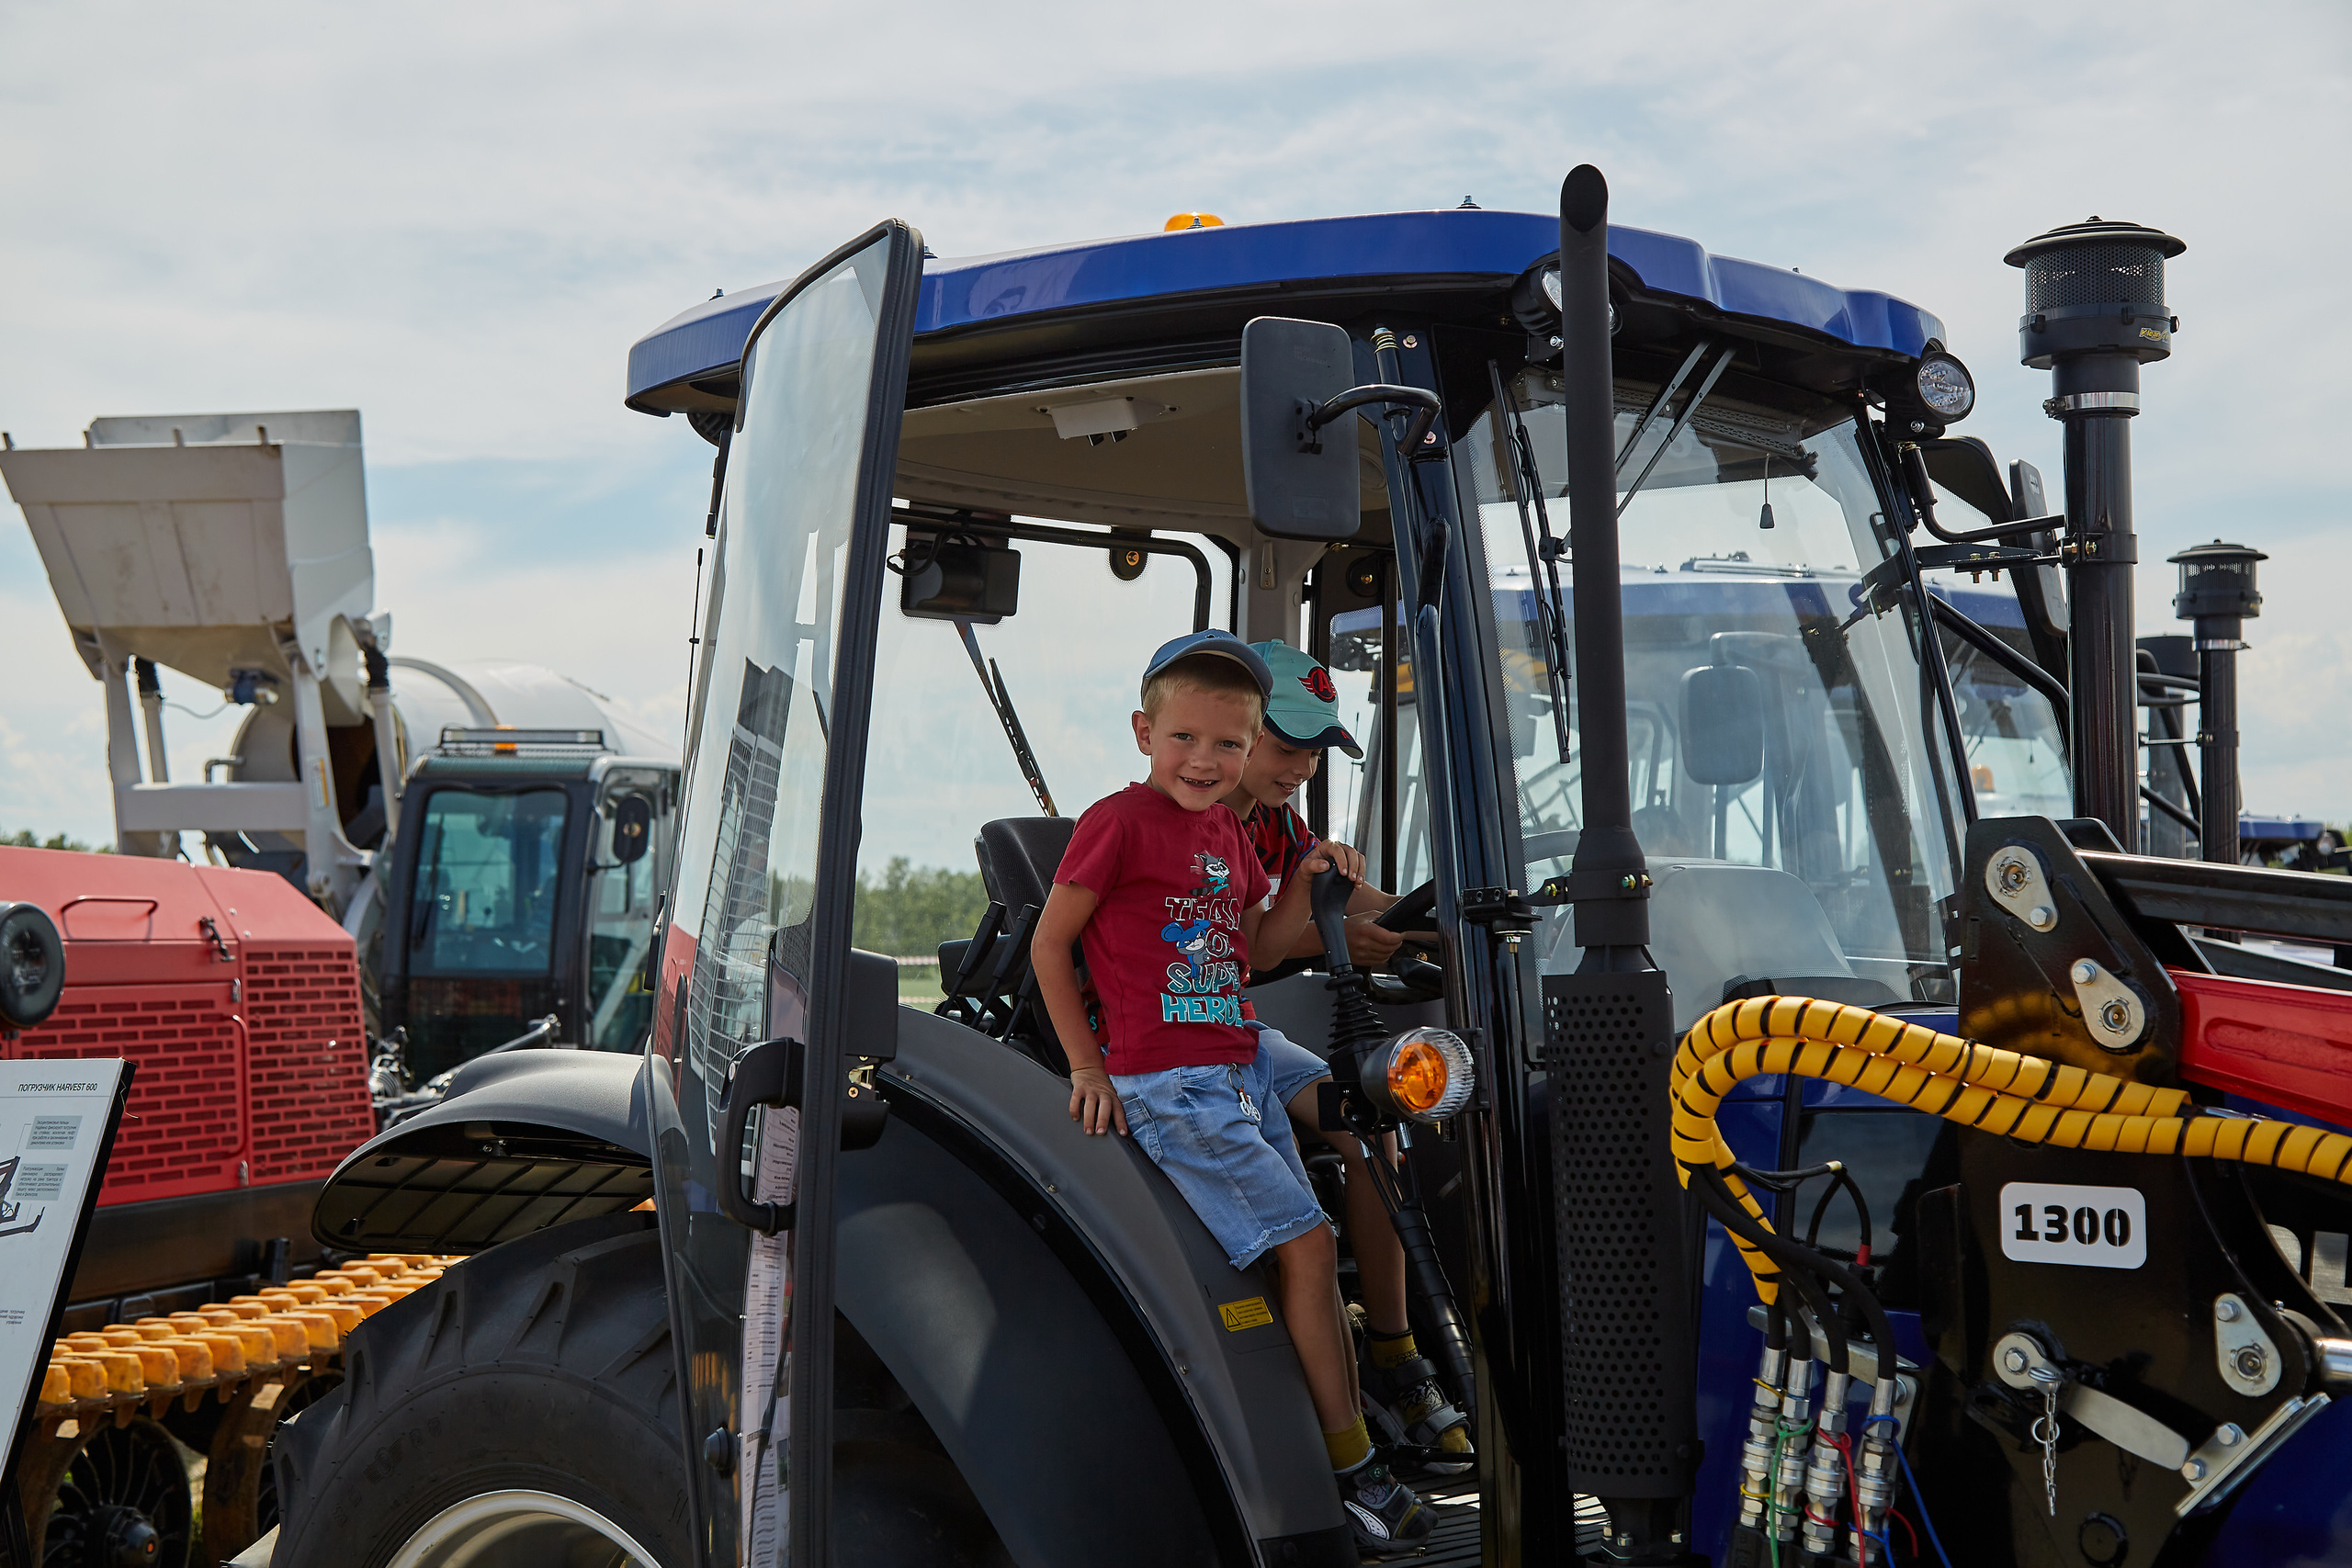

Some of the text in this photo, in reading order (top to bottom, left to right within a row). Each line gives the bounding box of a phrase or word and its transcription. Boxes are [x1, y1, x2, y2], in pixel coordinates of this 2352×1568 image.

[1166, 960, 1241, 994] SUPE
[17, 1083, 97, 1092] ПОГРУЗЧИК HARVEST 600
[2015, 1203, 2132, 1247] 1300
